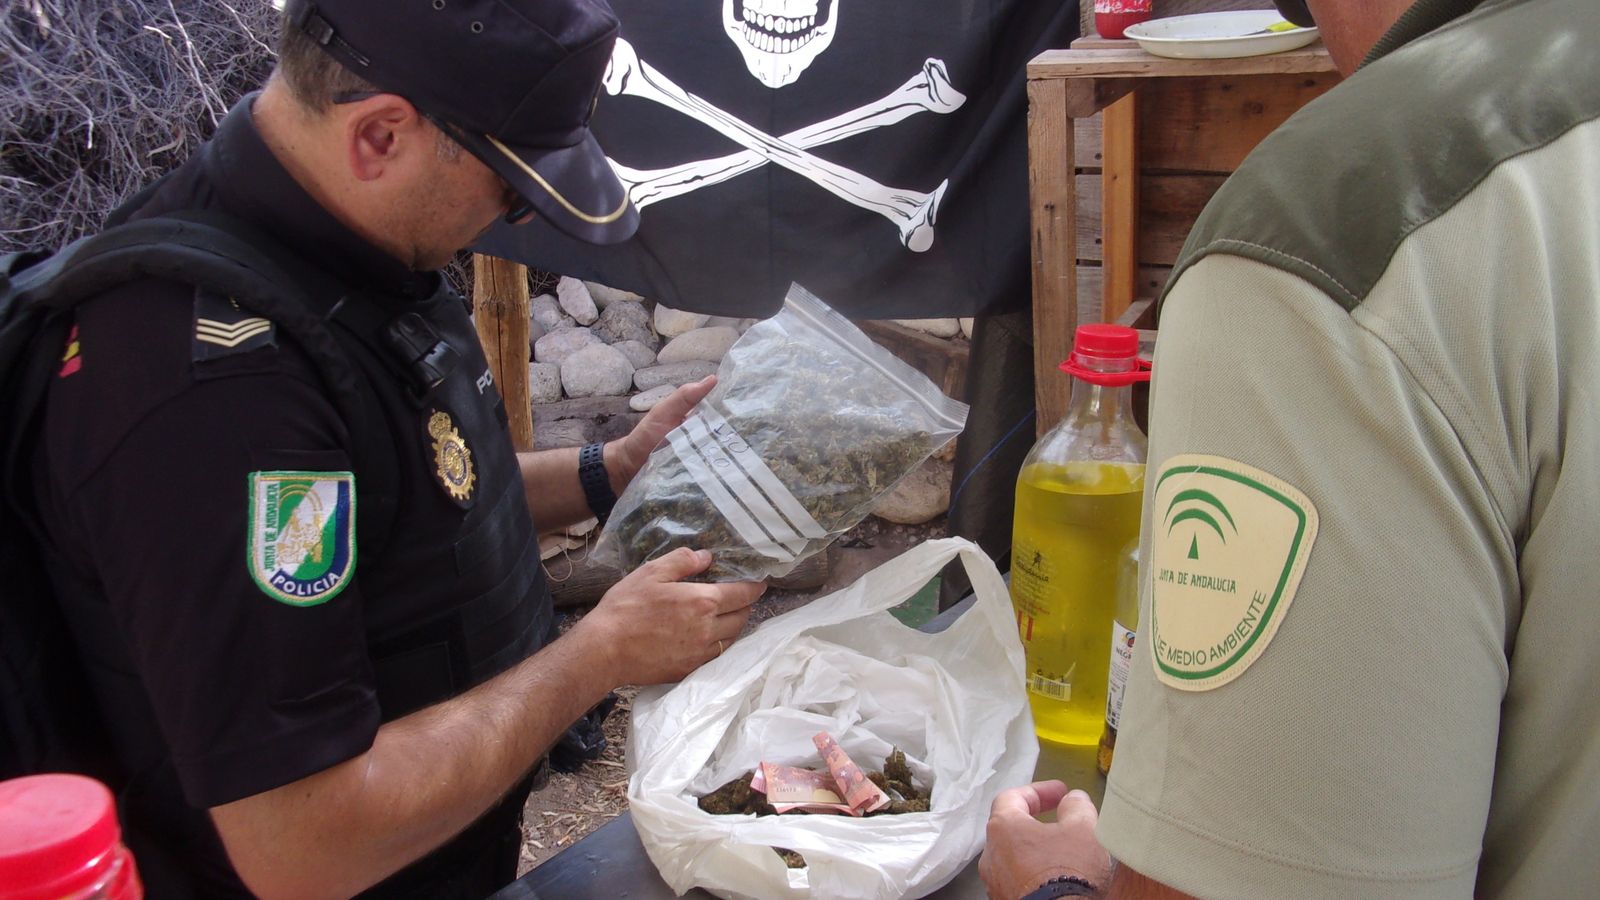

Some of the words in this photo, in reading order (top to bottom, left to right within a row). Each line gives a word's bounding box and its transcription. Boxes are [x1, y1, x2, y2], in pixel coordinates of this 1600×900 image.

[264, 531, 277, 542] DE
[273, 572, 341, 595] POLICIA
[1177, 572, 1189, 585] DE
[1191, 574, 1237, 594] ANDALUCIA
[1167, 648, 1207, 666] MEDIO
[1209, 589, 1267, 663] AMBIENTE
